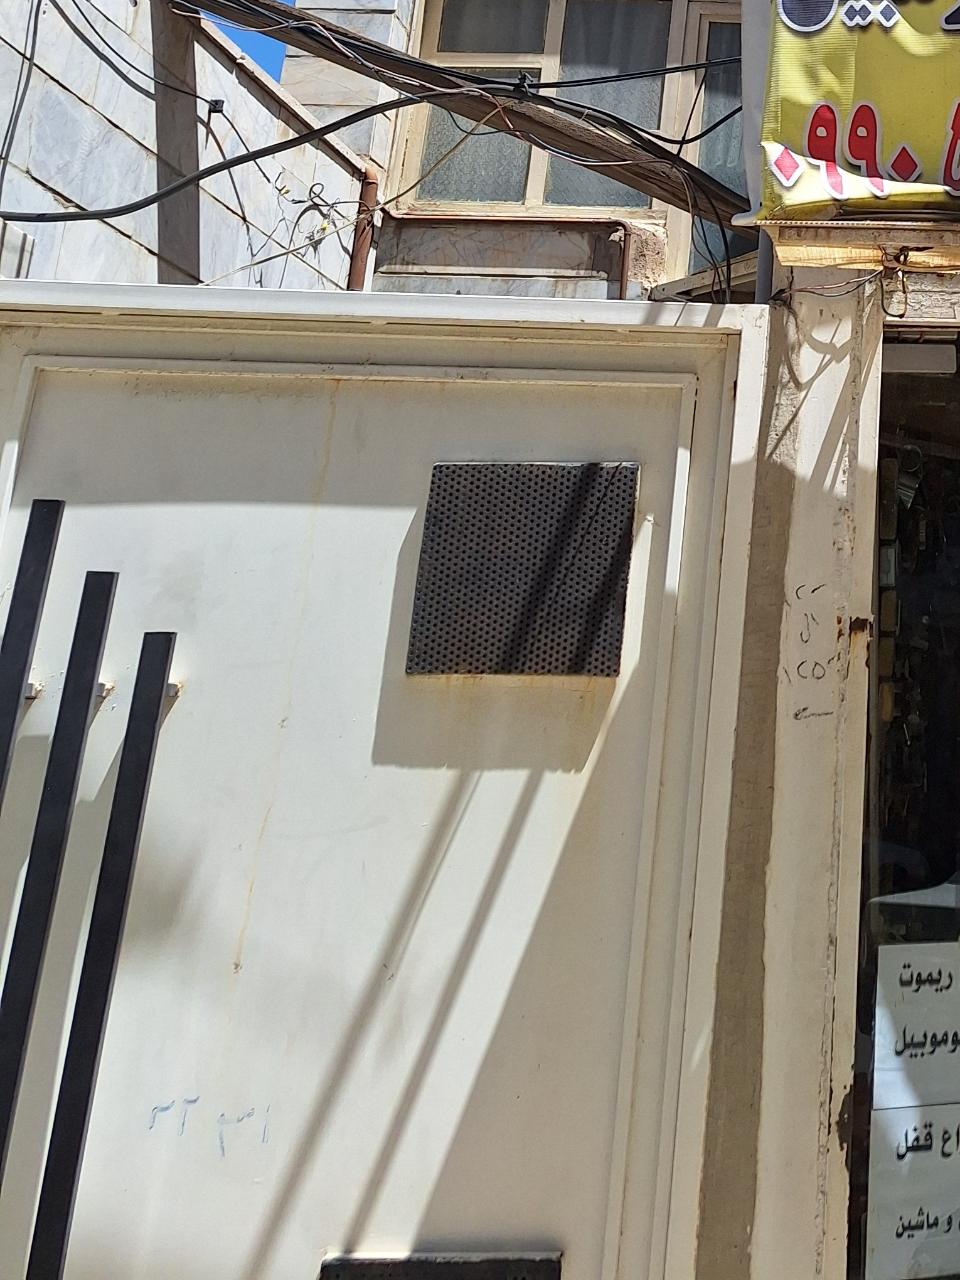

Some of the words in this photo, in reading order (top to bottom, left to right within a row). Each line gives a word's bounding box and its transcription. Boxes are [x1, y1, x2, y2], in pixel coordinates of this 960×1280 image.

[898, 963, 953, 993] ریموت
[896, 1121, 934, 1160] قفل
[895, 1206, 939, 1239] ماشین
[943, 1213, 953, 1233] و
